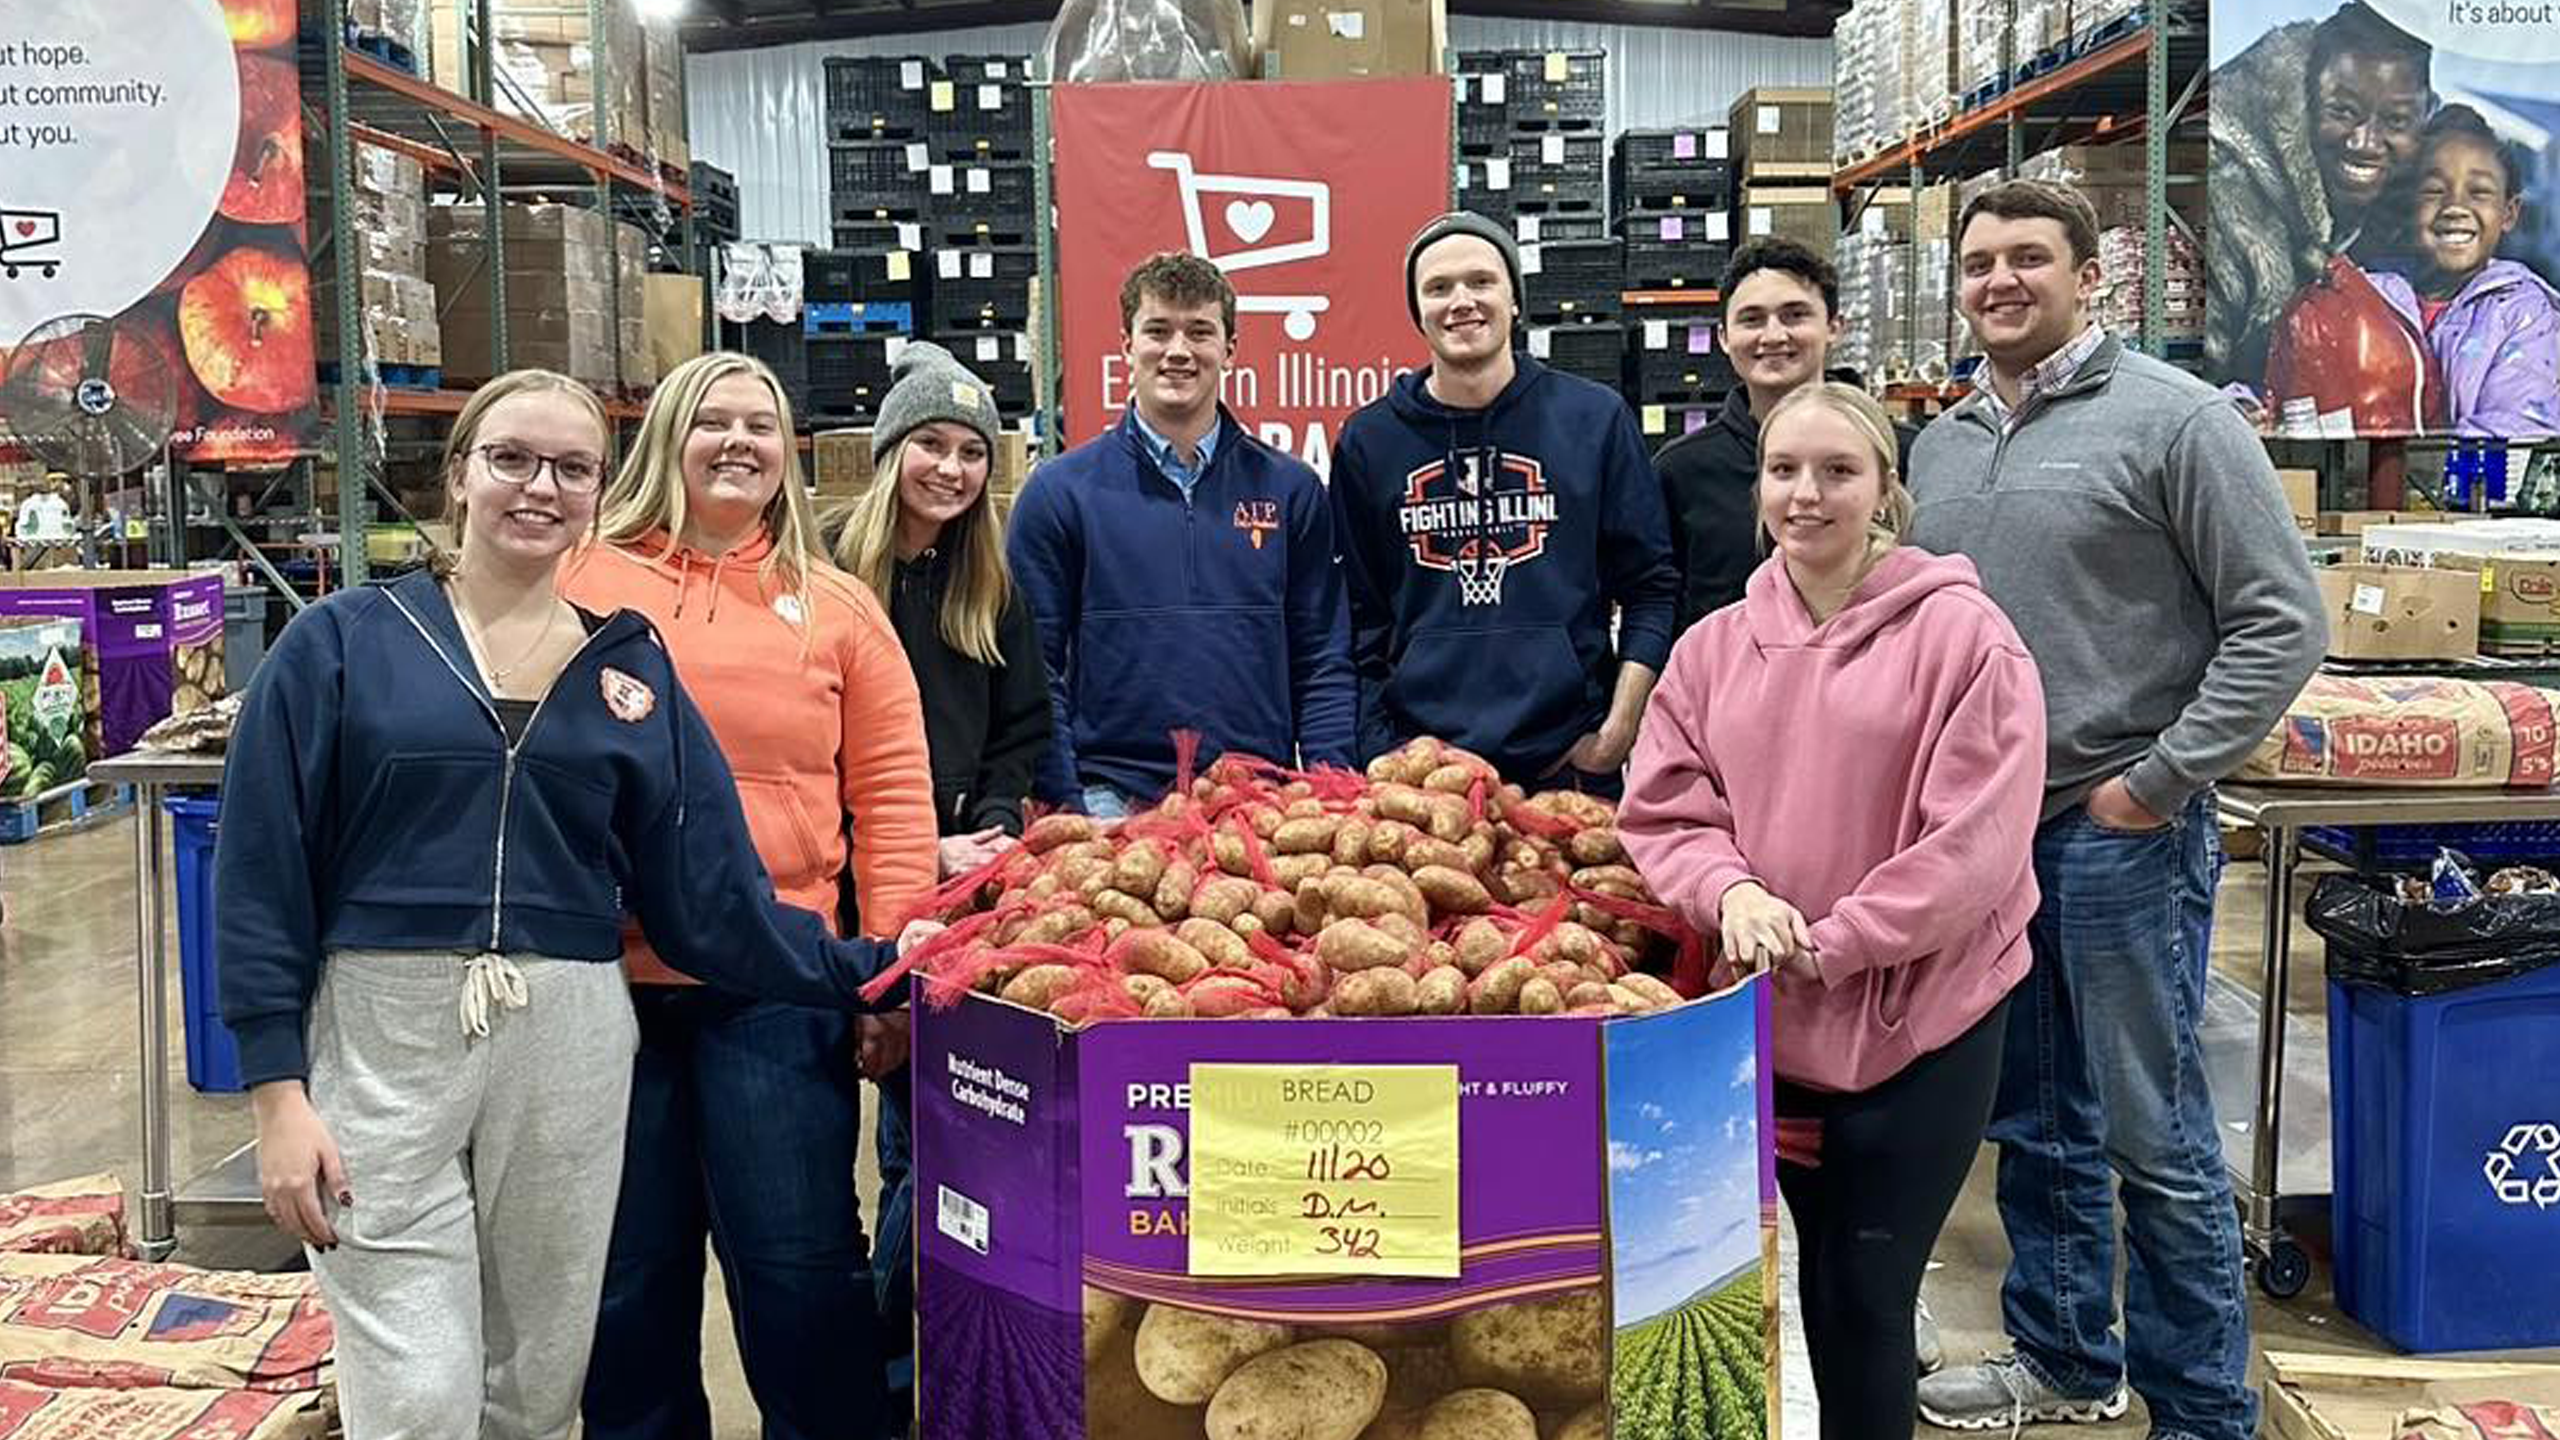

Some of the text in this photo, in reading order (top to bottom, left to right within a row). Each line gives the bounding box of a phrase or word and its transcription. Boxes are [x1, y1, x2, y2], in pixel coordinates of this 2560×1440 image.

[2449, 0, 2552, 23] It's about
[22, 40, 91, 70] hope.
[26, 78, 168, 107] community.
[26, 124, 78, 149] you.
[196, 425, 275, 442] Foundation
[2345, 732, 2447, 756] IDAHO
[947, 1051, 1029, 1101] Nutrient Dense
[1486, 1082, 1498, 1095] &
[1502, 1081, 1568, 1095] FLUFFY
[952, 1078, 1025, 1125] Carbohydrate
[1283, 1079, 1375, 1103] BREAD
[1284, 1119, 1383, 1145] #00002
[1307, 1143, 1391, 1182] 11/20
[1315, 1226, 1382, 1260] 342
